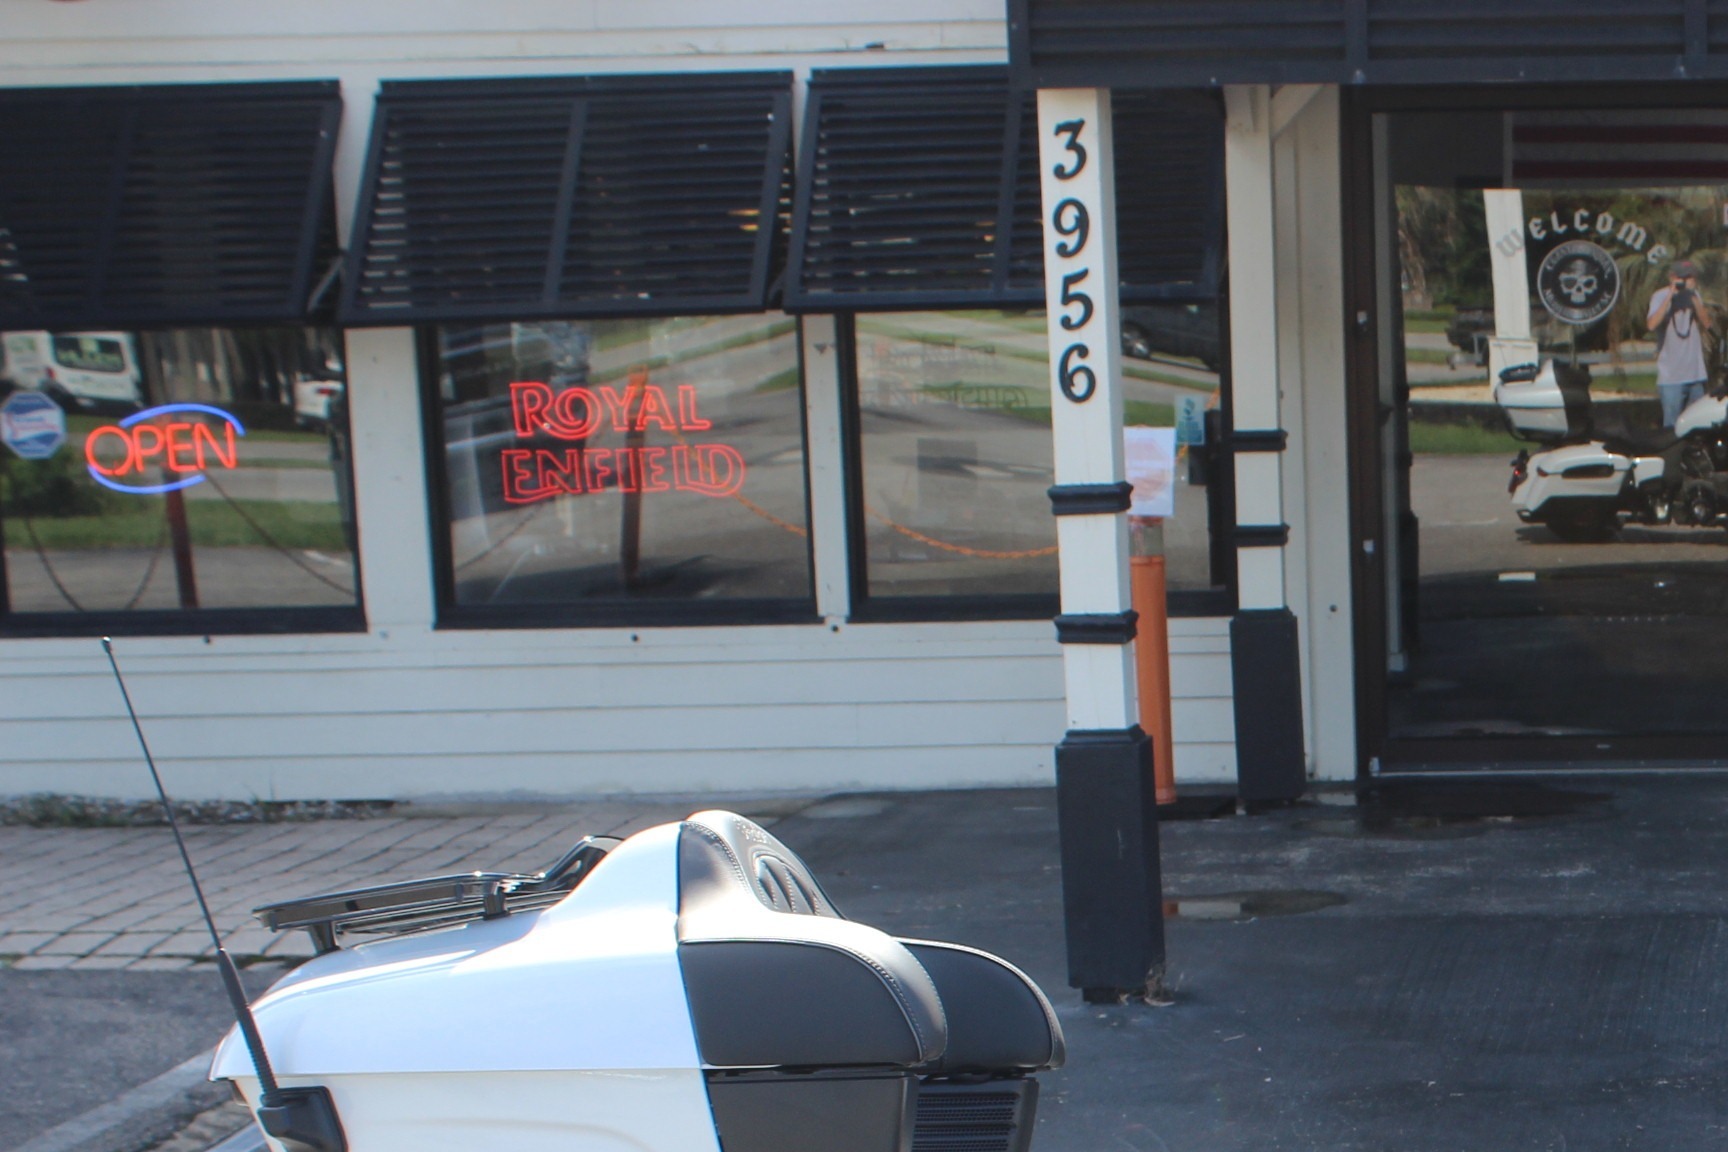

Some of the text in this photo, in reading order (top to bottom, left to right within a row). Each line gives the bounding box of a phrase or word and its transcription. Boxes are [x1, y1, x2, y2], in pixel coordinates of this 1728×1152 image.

[1052, 118, 1097, 404] 3956
[509, 381, 713, 440] ROYAL
[85, 421, 237, 477] OPEN
[502, 443, 746, 504] ENFIELD
